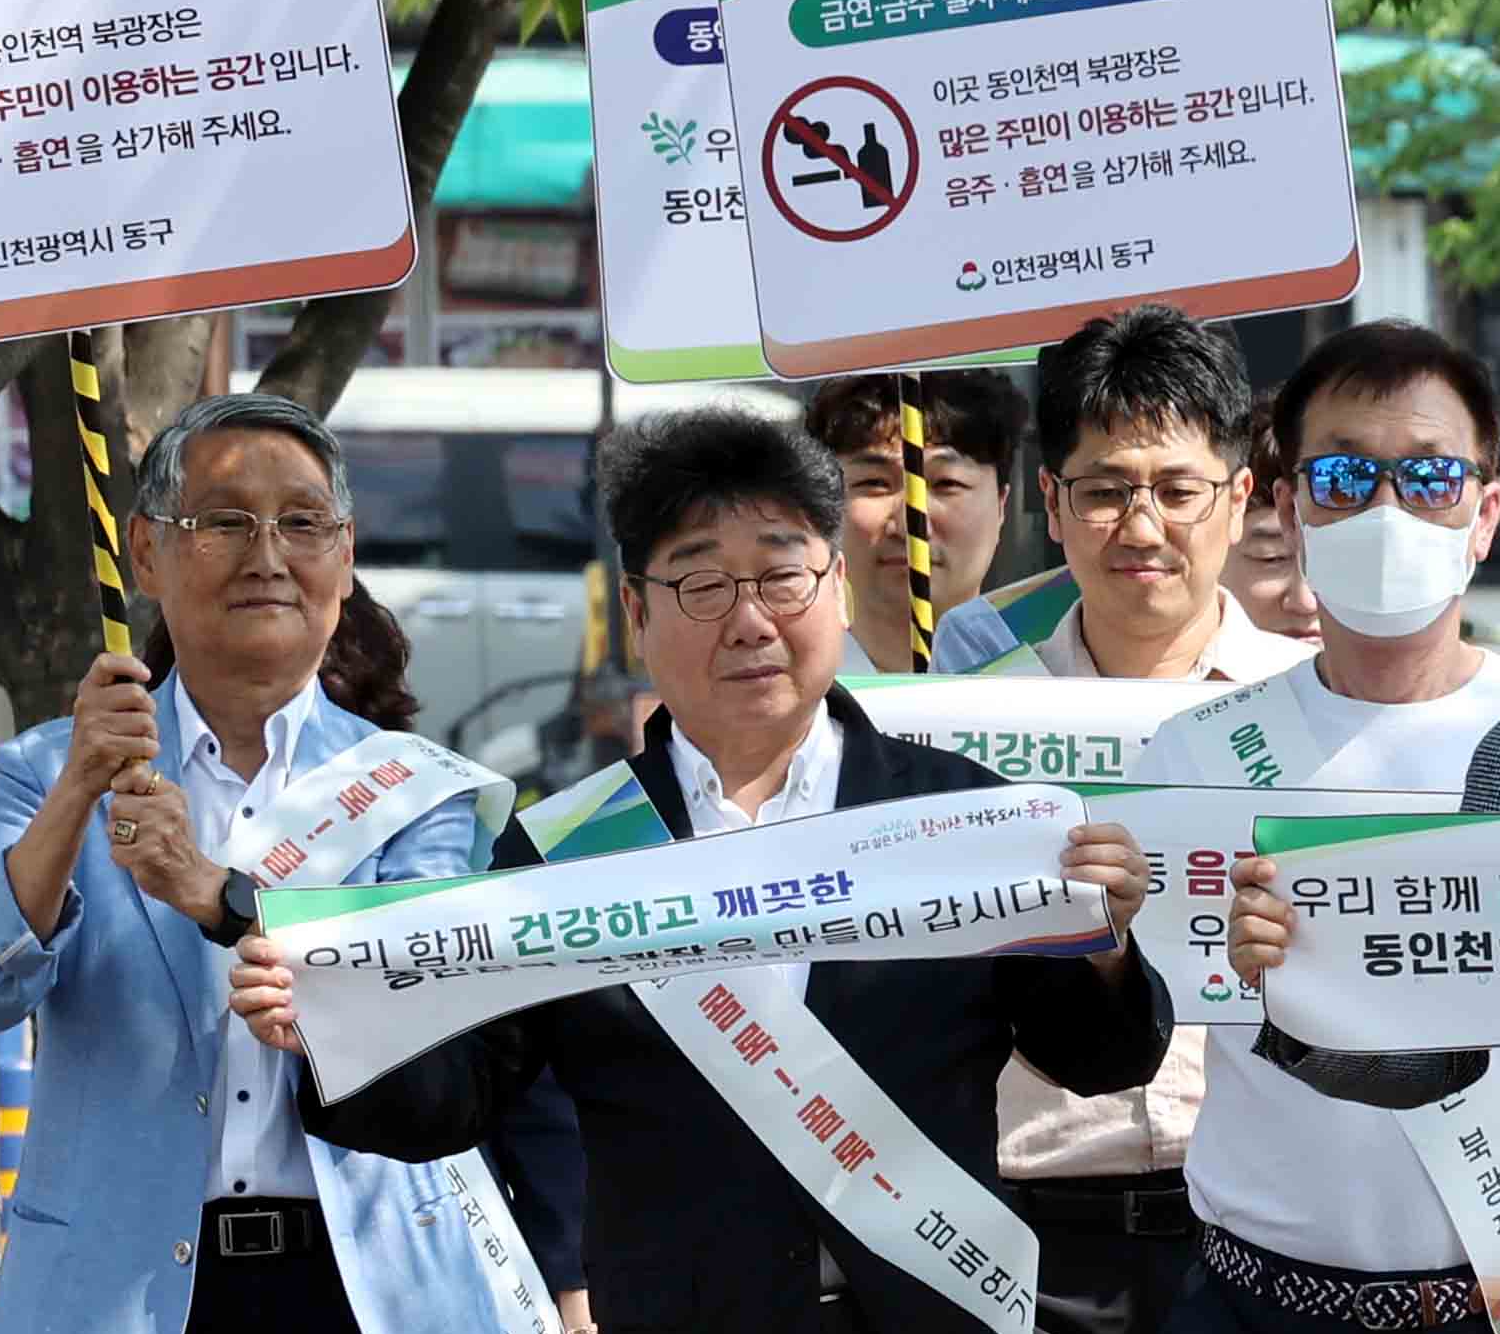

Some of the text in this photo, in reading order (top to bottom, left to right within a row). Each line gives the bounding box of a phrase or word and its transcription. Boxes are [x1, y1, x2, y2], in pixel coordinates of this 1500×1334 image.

[91, 7, 202, 51] 북광장은
[83, 64, 199, 109] 이용하는
[933, 46, 1181, 107] 이곳 동인천역 북광장은
[111, 124, 193, 162] 삼가해
[201, 108, 292, 147] 주세요.
[938, 122, 988, 159] 많은
[996, 109, 1070, 149] 주민이
[1078, 96, 1176, 138] 이용하는
[945, 174, 996, 209] 음주
[1102, 151, 1173, 187] 삼가해
[1179, 139, 1256, 174] 주세요.
[123, 218, 174, 250] 동구
[992, 239, 1156, 286] 인천광역시 동구
[408, 870, 855, 966] 함께 건강하고 깨끗한
[919, 880, 1073, 932] 갑시다!
[1293, 876, 1375, 917] 우리
[1398, 874, 1481, 915] 함께
